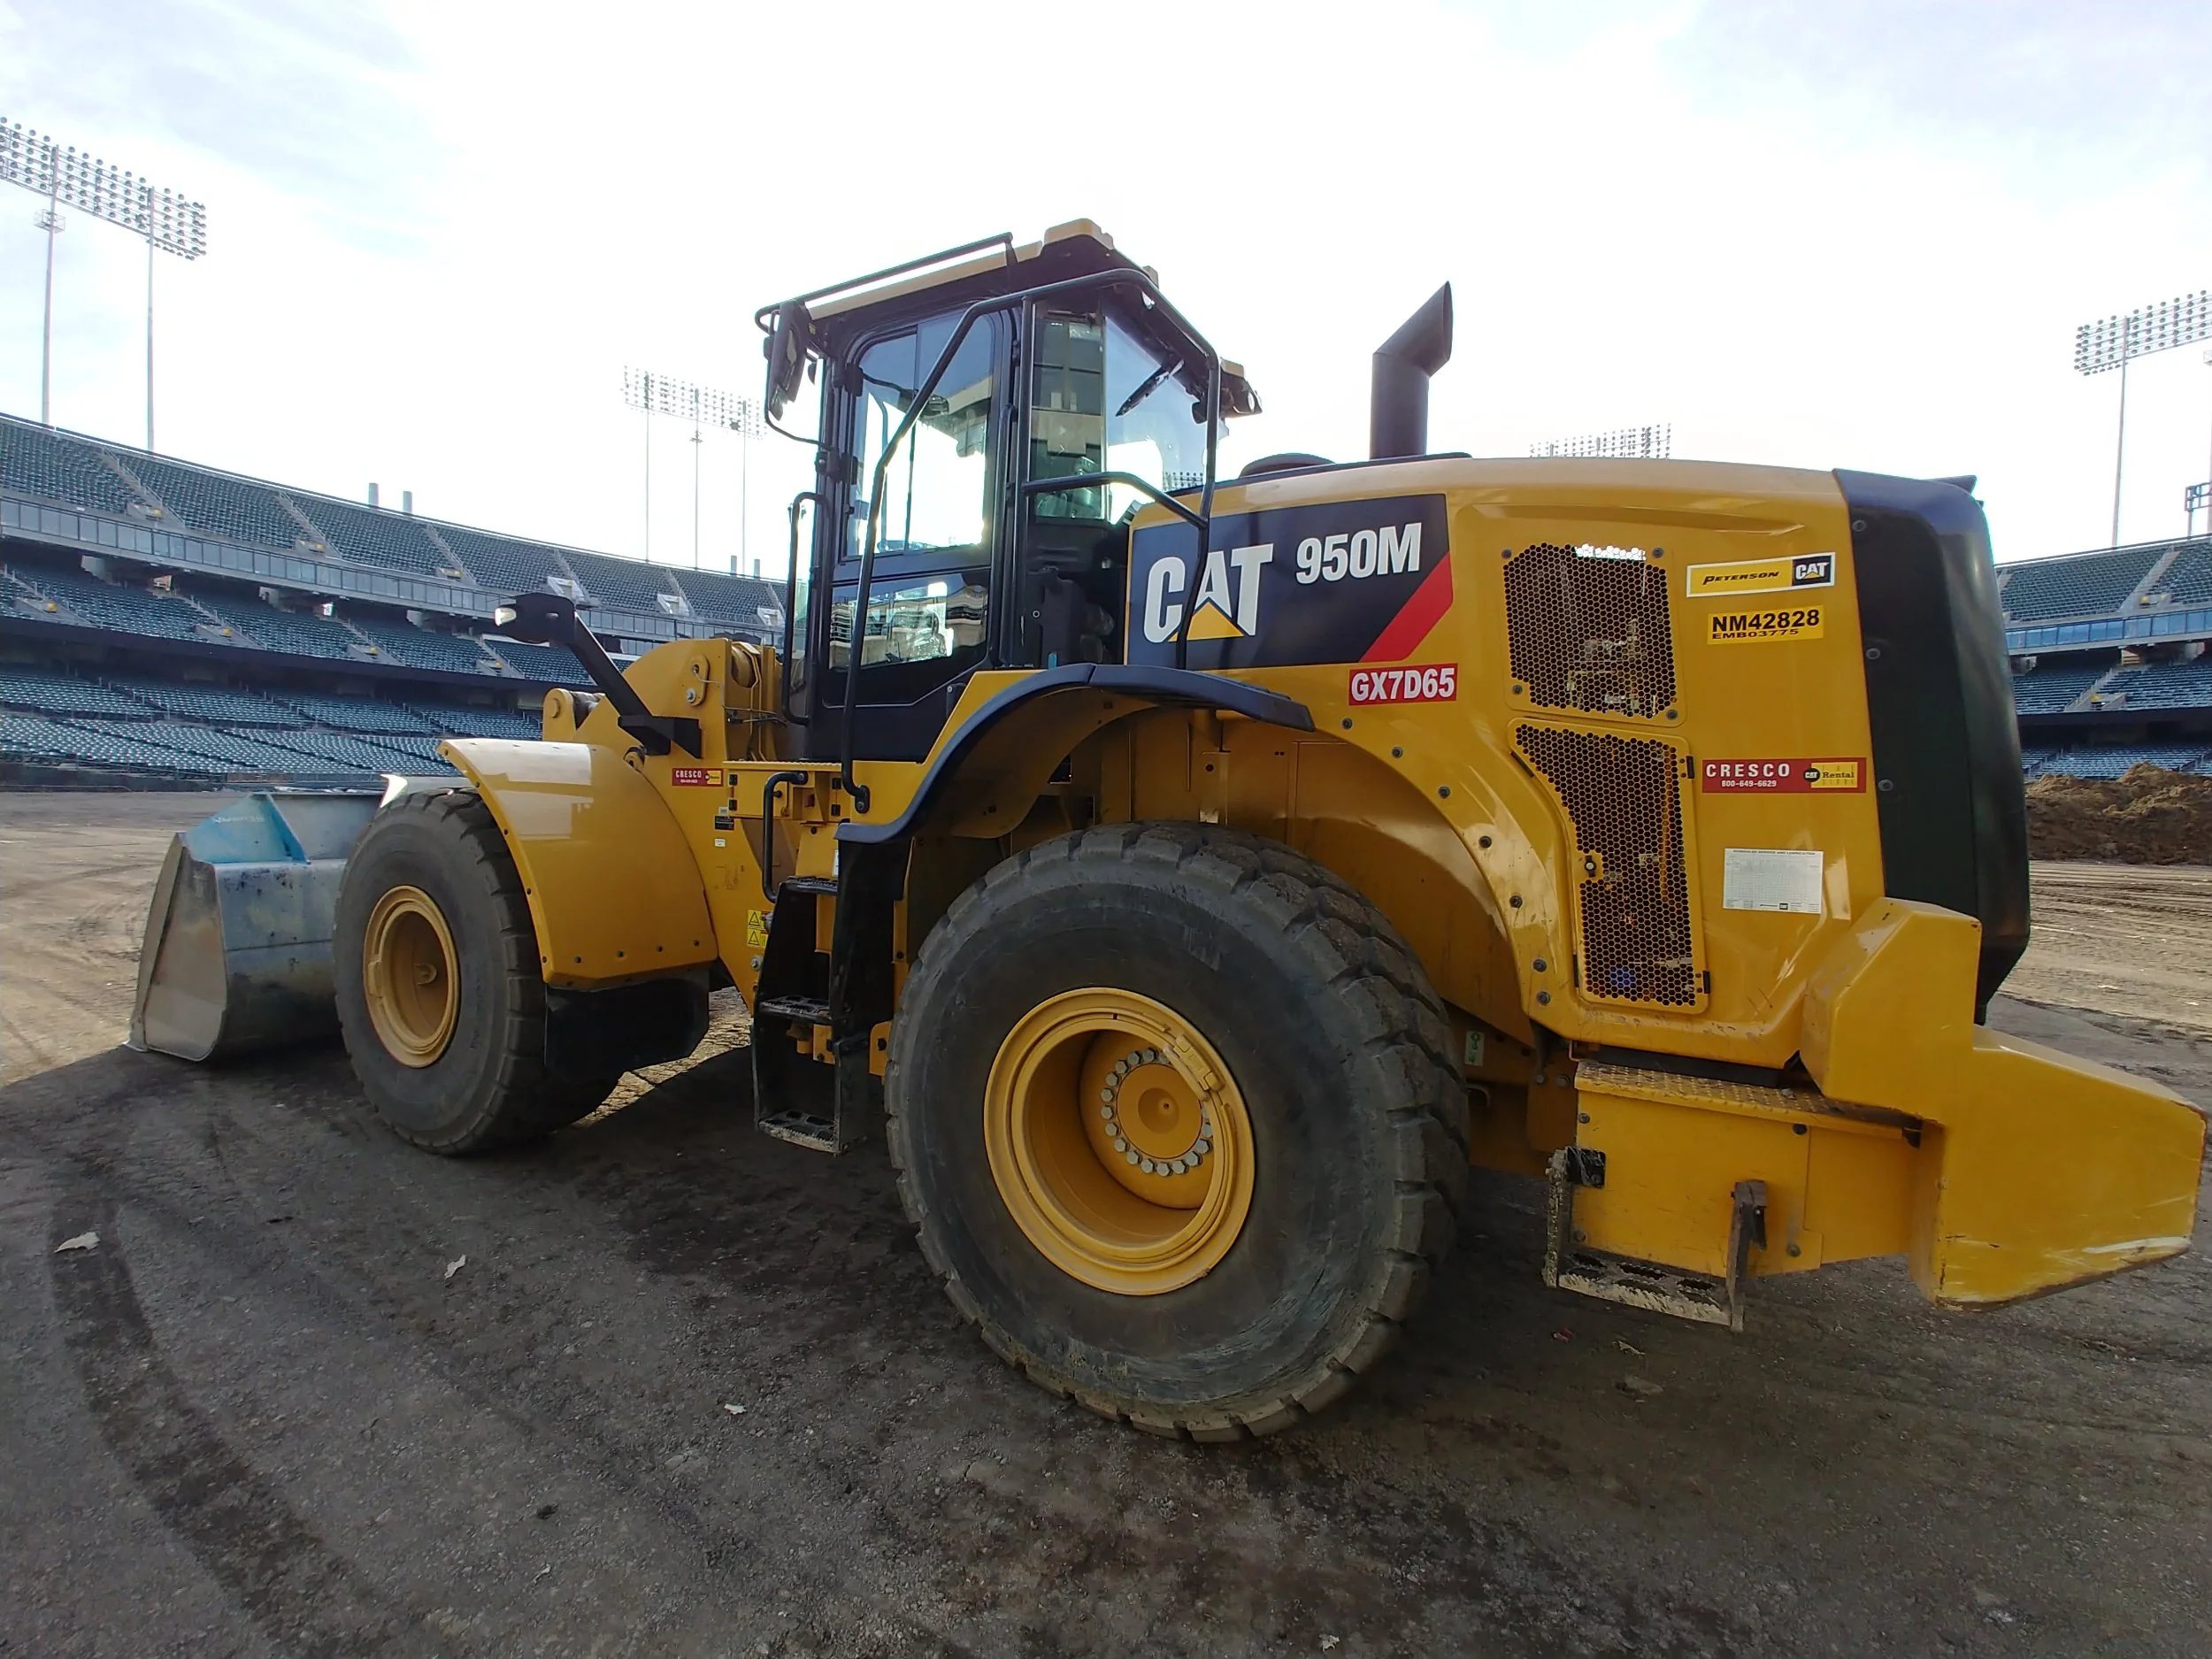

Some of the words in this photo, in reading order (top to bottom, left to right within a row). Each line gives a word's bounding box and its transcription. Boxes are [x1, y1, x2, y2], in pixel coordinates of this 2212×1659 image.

[1795, 562, 1829, 580] CAT
[1143, 542, 1274, 644] CAT
[1295, 521, 1423, 586] 950M
[1712, 609, 1820, 633] NM42828
[1711, 628, 1800, 640] EMB03775
[1350, 667, 1455, 702] GX7D65
[1706, 763, 1791, 778] CRESCO
